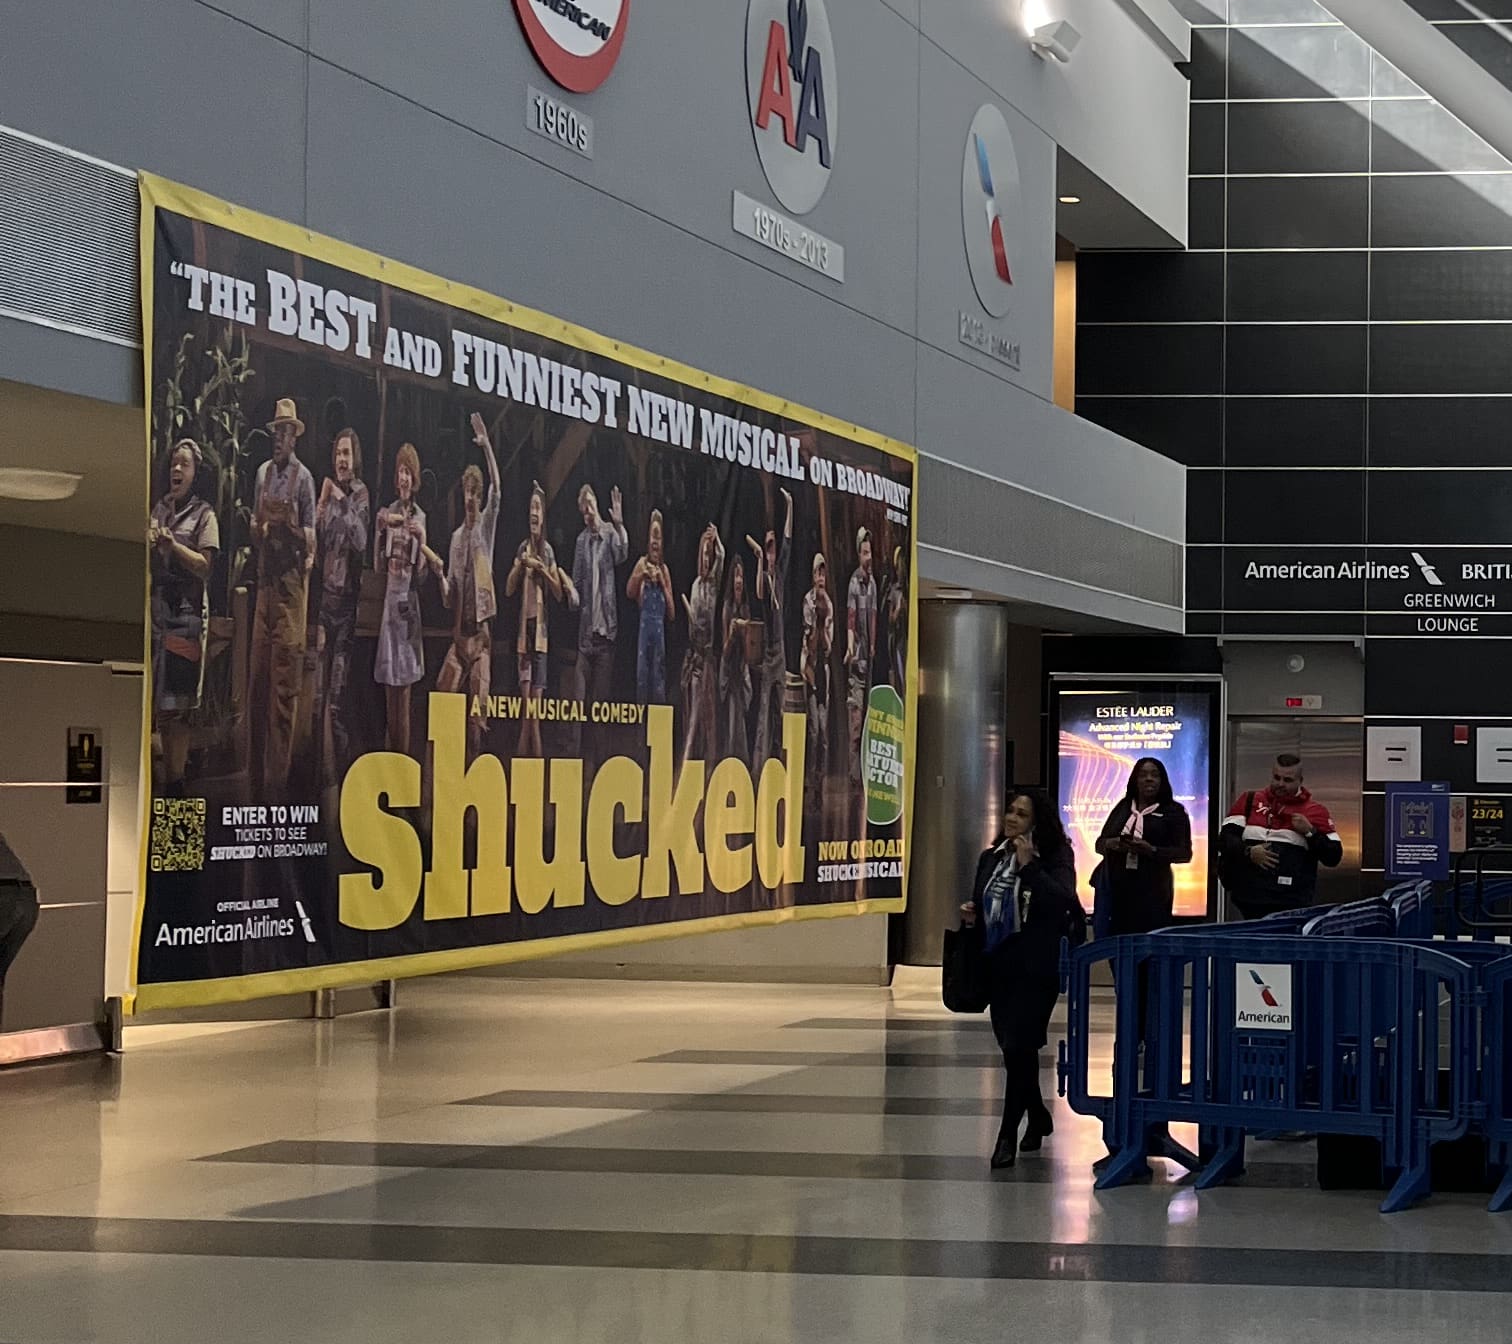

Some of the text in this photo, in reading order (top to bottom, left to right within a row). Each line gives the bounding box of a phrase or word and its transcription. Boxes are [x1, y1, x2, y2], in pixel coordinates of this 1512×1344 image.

[534, 95, 588, 153] 1960s
[754, 207, 790, 251] 1970s
[799, 232, 829, 270] 2013
[266, 269, 377, 359] BEST
[383, 326, 442, 378] AND
[451, 329, 621, 428] FUNNIEST
[627, 384, 695, 449] NEW
[700, 408, 805, 480] MUSICAL
[810, 455, 833, 488] ON
[1244, 561, 1336, 579] American
[1337, 561, 1410, 580] Airlines
[1403, 593, 1496, 608] GREENWICH
[1417, 617, 1479, 632] LOUNGE
[470, 694, 645, 724] A NEW MUSICAL COMEDY
[1131, 706, 1174, 717] LAUDER
[1131, 721, 1154, 733] Night
[1155, 721, 1182, 733] Repair
[870, 738, 897, 760] BEST
[222, 805, 319, 825] ENTER TO WIN
[338, 691, 806, 931] shucked
[1471, 808, 1504, 820] 23/24
[234, 827, 307, 842] TICKETS TO SEE
[257, 844, 272, 858] ON
[818, 840, 848, 861] NOW
[154, 914, 294, 947] American Airlines
[1238, 1010, 1290, 1024] American
